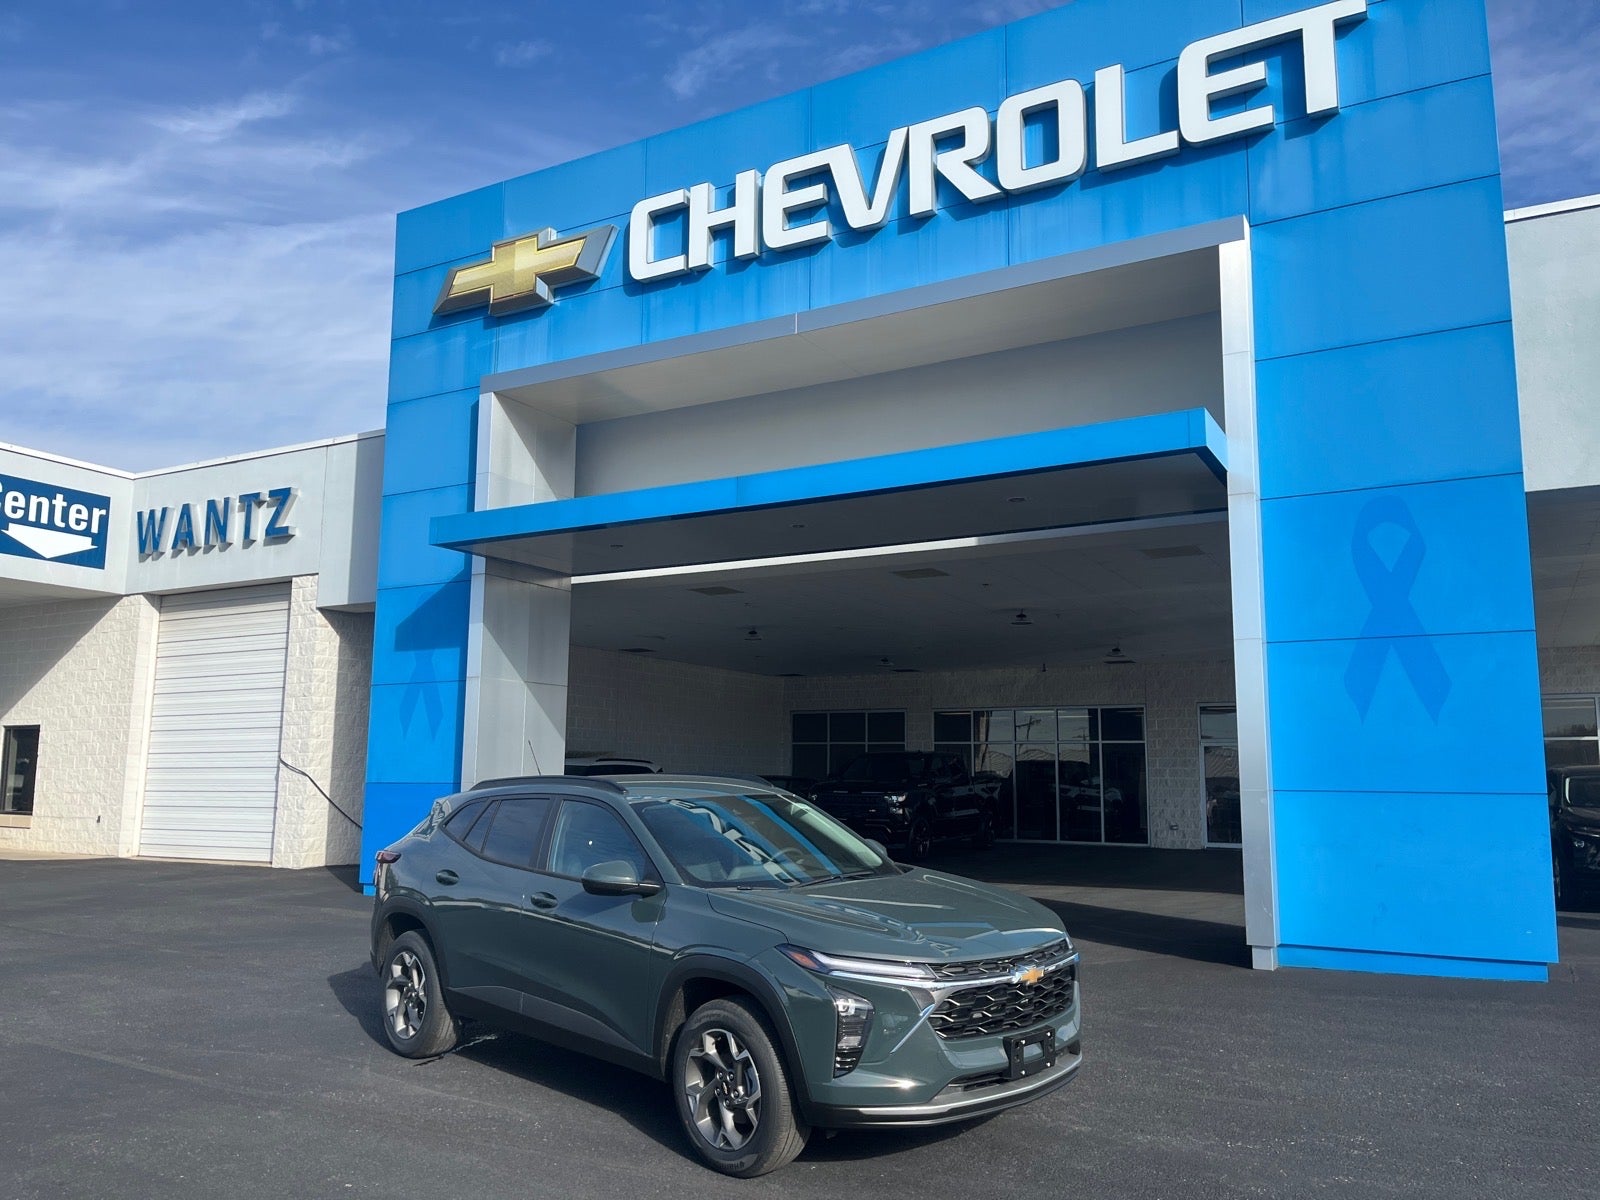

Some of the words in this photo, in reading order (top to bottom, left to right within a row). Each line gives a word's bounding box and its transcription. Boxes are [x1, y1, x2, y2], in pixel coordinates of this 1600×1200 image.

[628, 0, 1367, 282] CHEVROLET
[0, 480, 107, 534] enter
[137, 486, 297, 560] WANTZ
